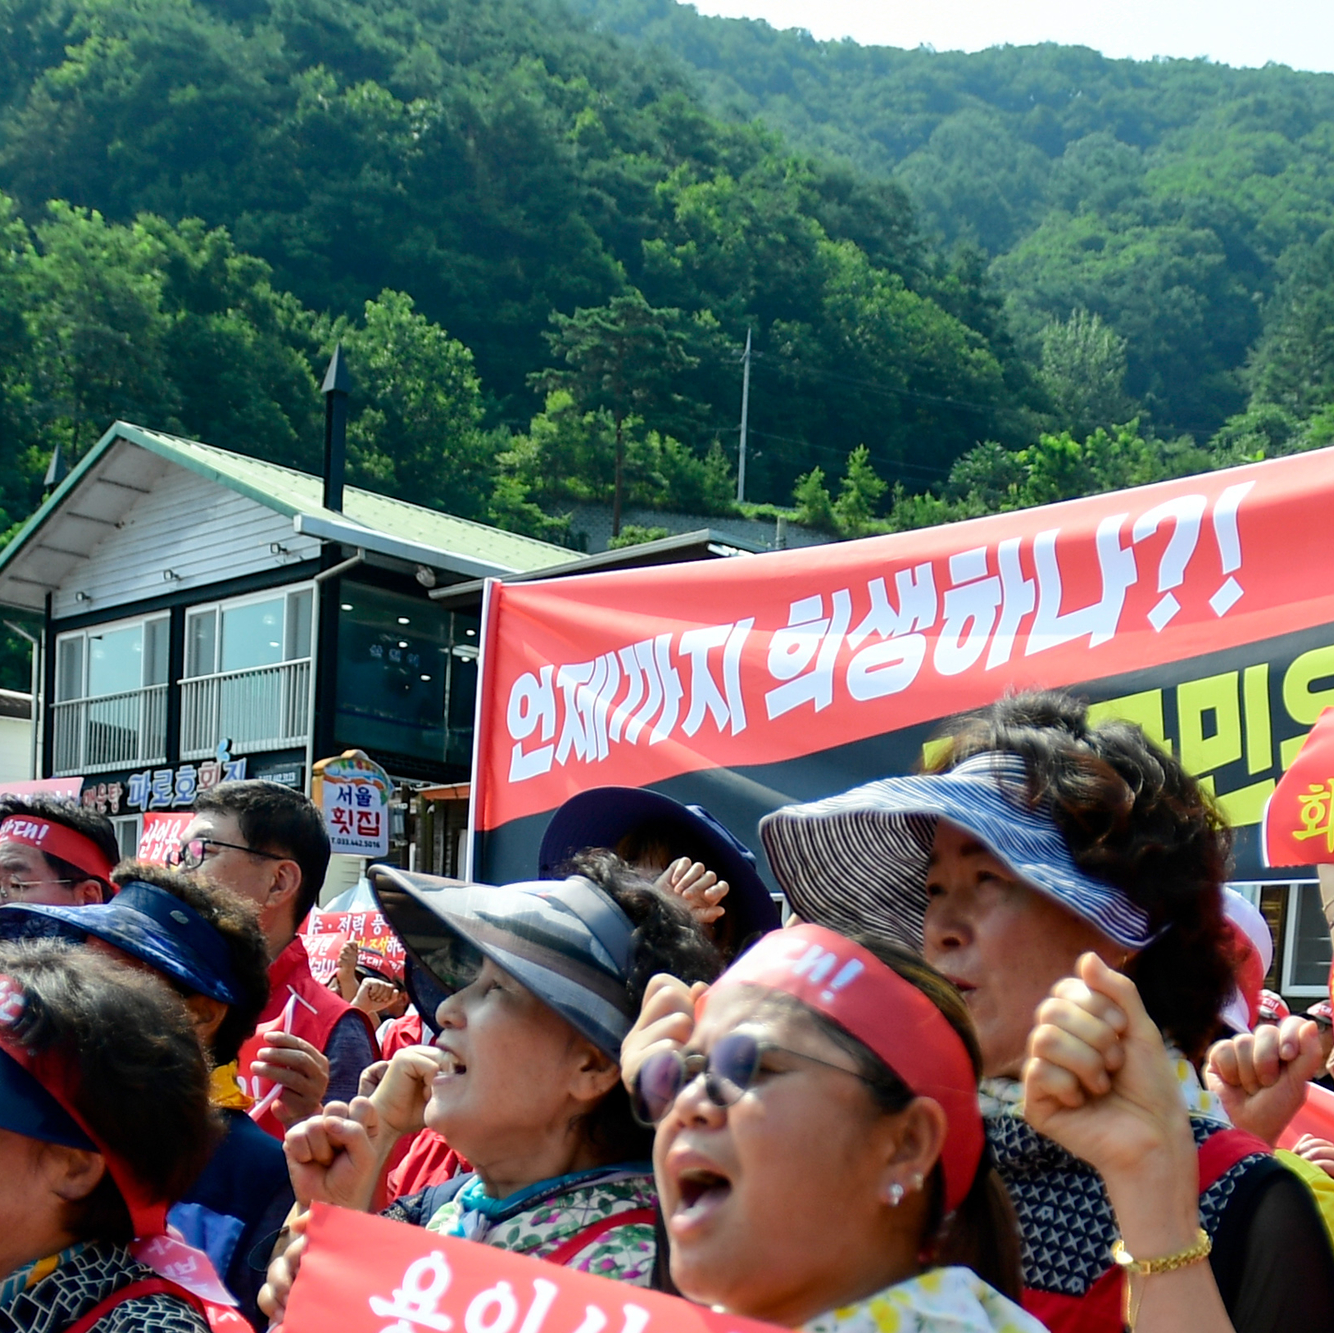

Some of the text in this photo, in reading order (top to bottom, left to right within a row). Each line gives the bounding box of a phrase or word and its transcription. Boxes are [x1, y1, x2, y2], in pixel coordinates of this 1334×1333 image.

[507, 479, 1255, 783] 언제까지 희생하나?!
[336, 785, 373, 807] 서울
[330, 806, 381, 838] 횟집
[337, 913, 366, 936] 전력
